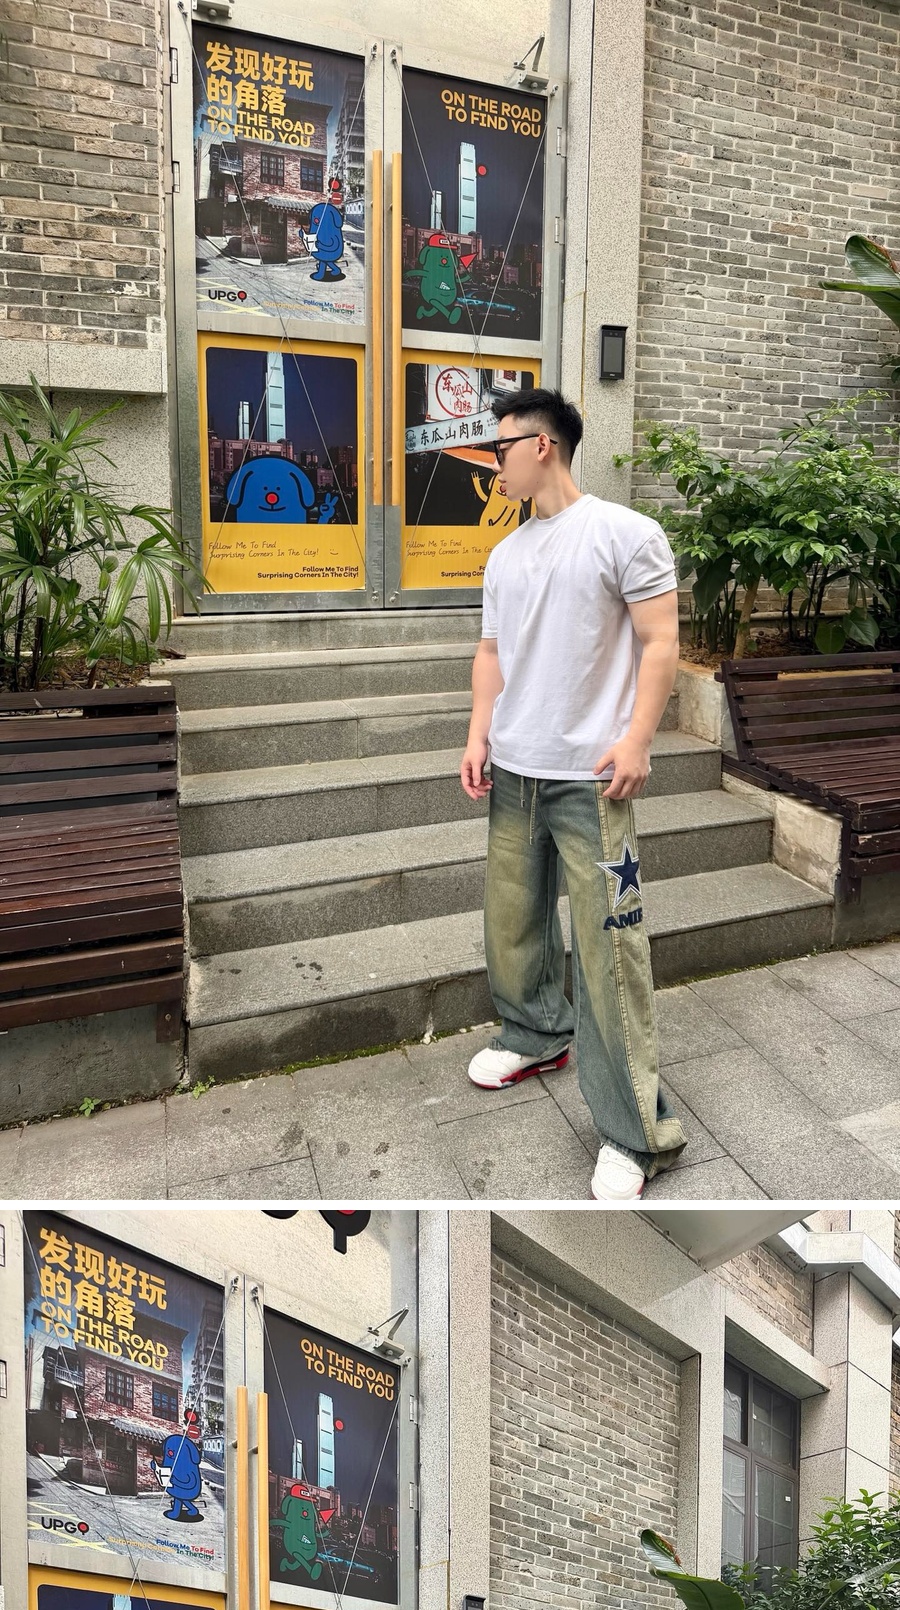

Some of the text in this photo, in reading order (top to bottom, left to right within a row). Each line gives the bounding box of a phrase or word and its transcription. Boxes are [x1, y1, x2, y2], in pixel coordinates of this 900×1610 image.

[205, 41, 314, 91] 发现好玩
[206, 73, 287, 116] 的角落
[441, 89, 542, 123] ON THE ROAD
[207, 105, 315, 136] ON THE ROAD
[207, 119, 311, 148] TO FIND YOU
[445, 105, 541, 138] TO FIND YOU
[420, 420, 484, 446] 东瓜山肉肠
[208, 541, 277, 550] Follow Me To Find
[209, 550, 245, 559] Surprising
[249, 550, 273, 558] Corners
[277, 549, 285, 557] In
[303, 548, 319, 557] City!
[343, 571, 359, 579] City!
[39, 1227, 167, 1311] 发现好玩
[40, 1265, 136, 1331] 的角落
[41, 1301, 169, 1358] ON THE ROAD
[41, 1316, 164, 1371] TO FIND YOU
[301, 1338, 395, 1388] ON THE ROAD
[305, 1355, 394, 1401] TO FIND YOU
[156, 1538, 180, 1549] Follow
